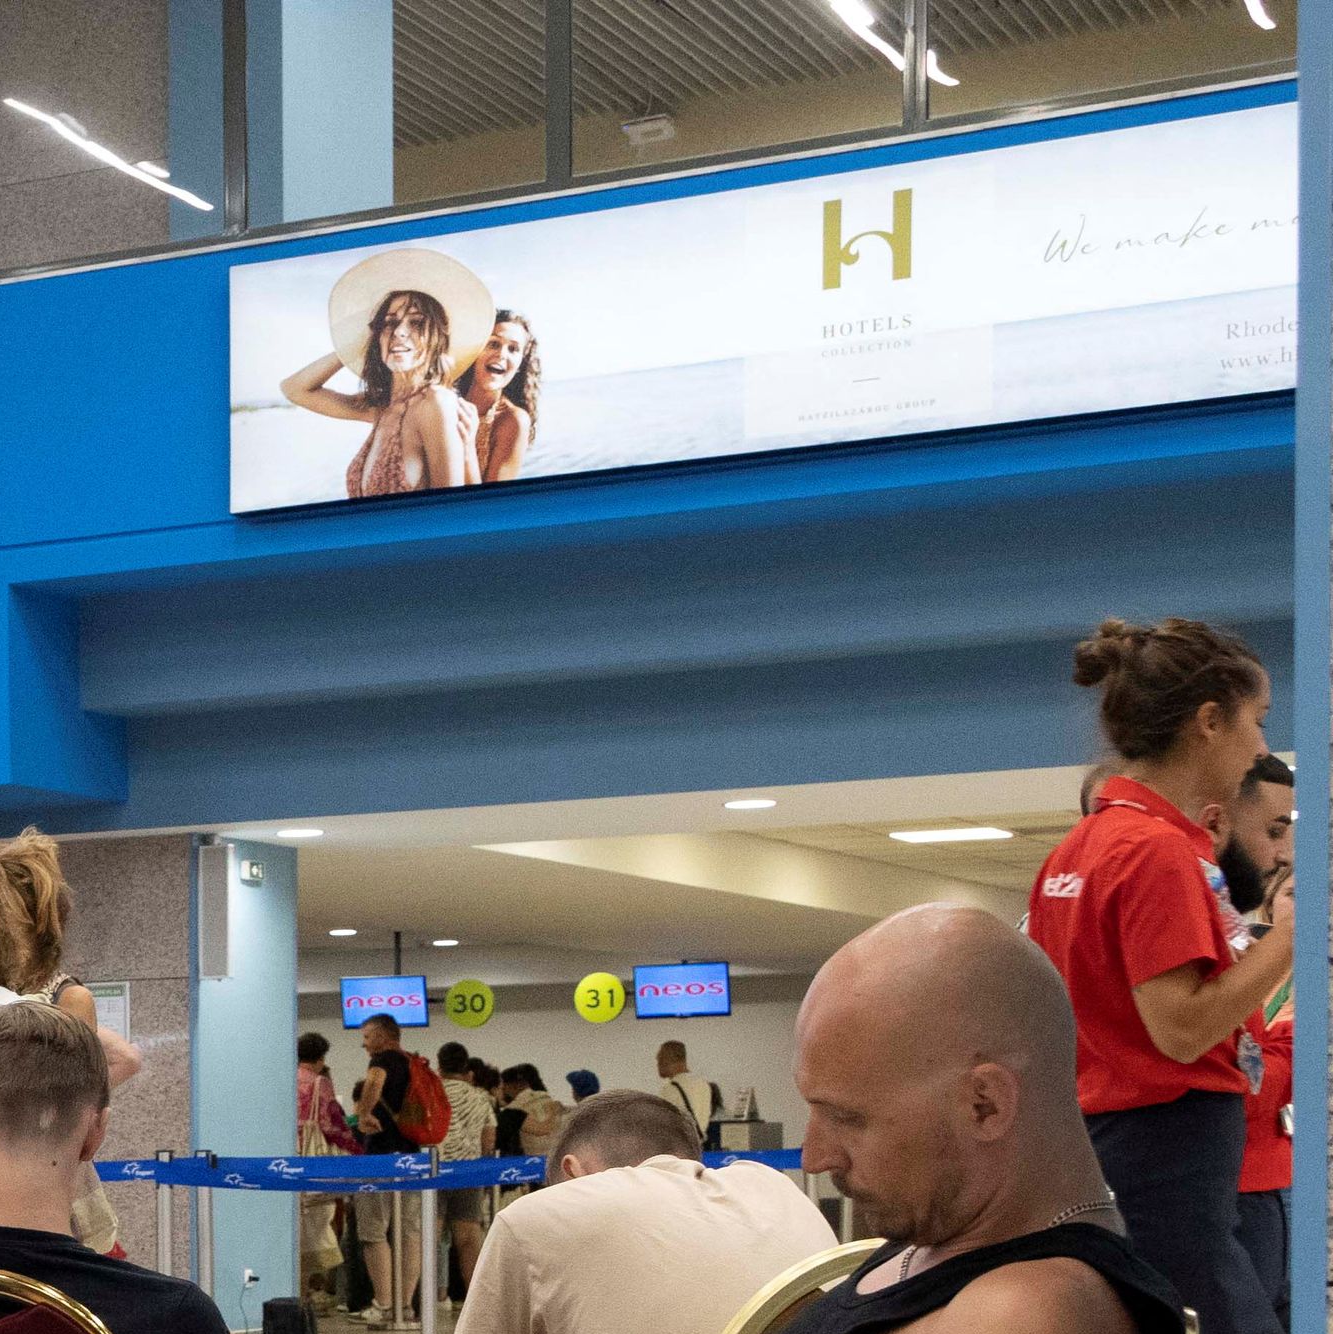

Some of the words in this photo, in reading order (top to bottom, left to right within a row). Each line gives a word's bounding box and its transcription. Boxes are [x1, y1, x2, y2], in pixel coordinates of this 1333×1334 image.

[1043, 213, 1099, 263] We
[1114, 206, 1233, 250] make
[822, 313, 913, 340] HOTELS
[1226, 316, 1299, 340] Rhode
[821, 338, 913, 359] COLLECTION
[895, 397, 938, 412] GROUP
[586, 988, 615, 1008] 31
[639, 981, 725, 998] neos
[345, 993, 422, 1008] neos
[453, 993, 485, 1013] 30
